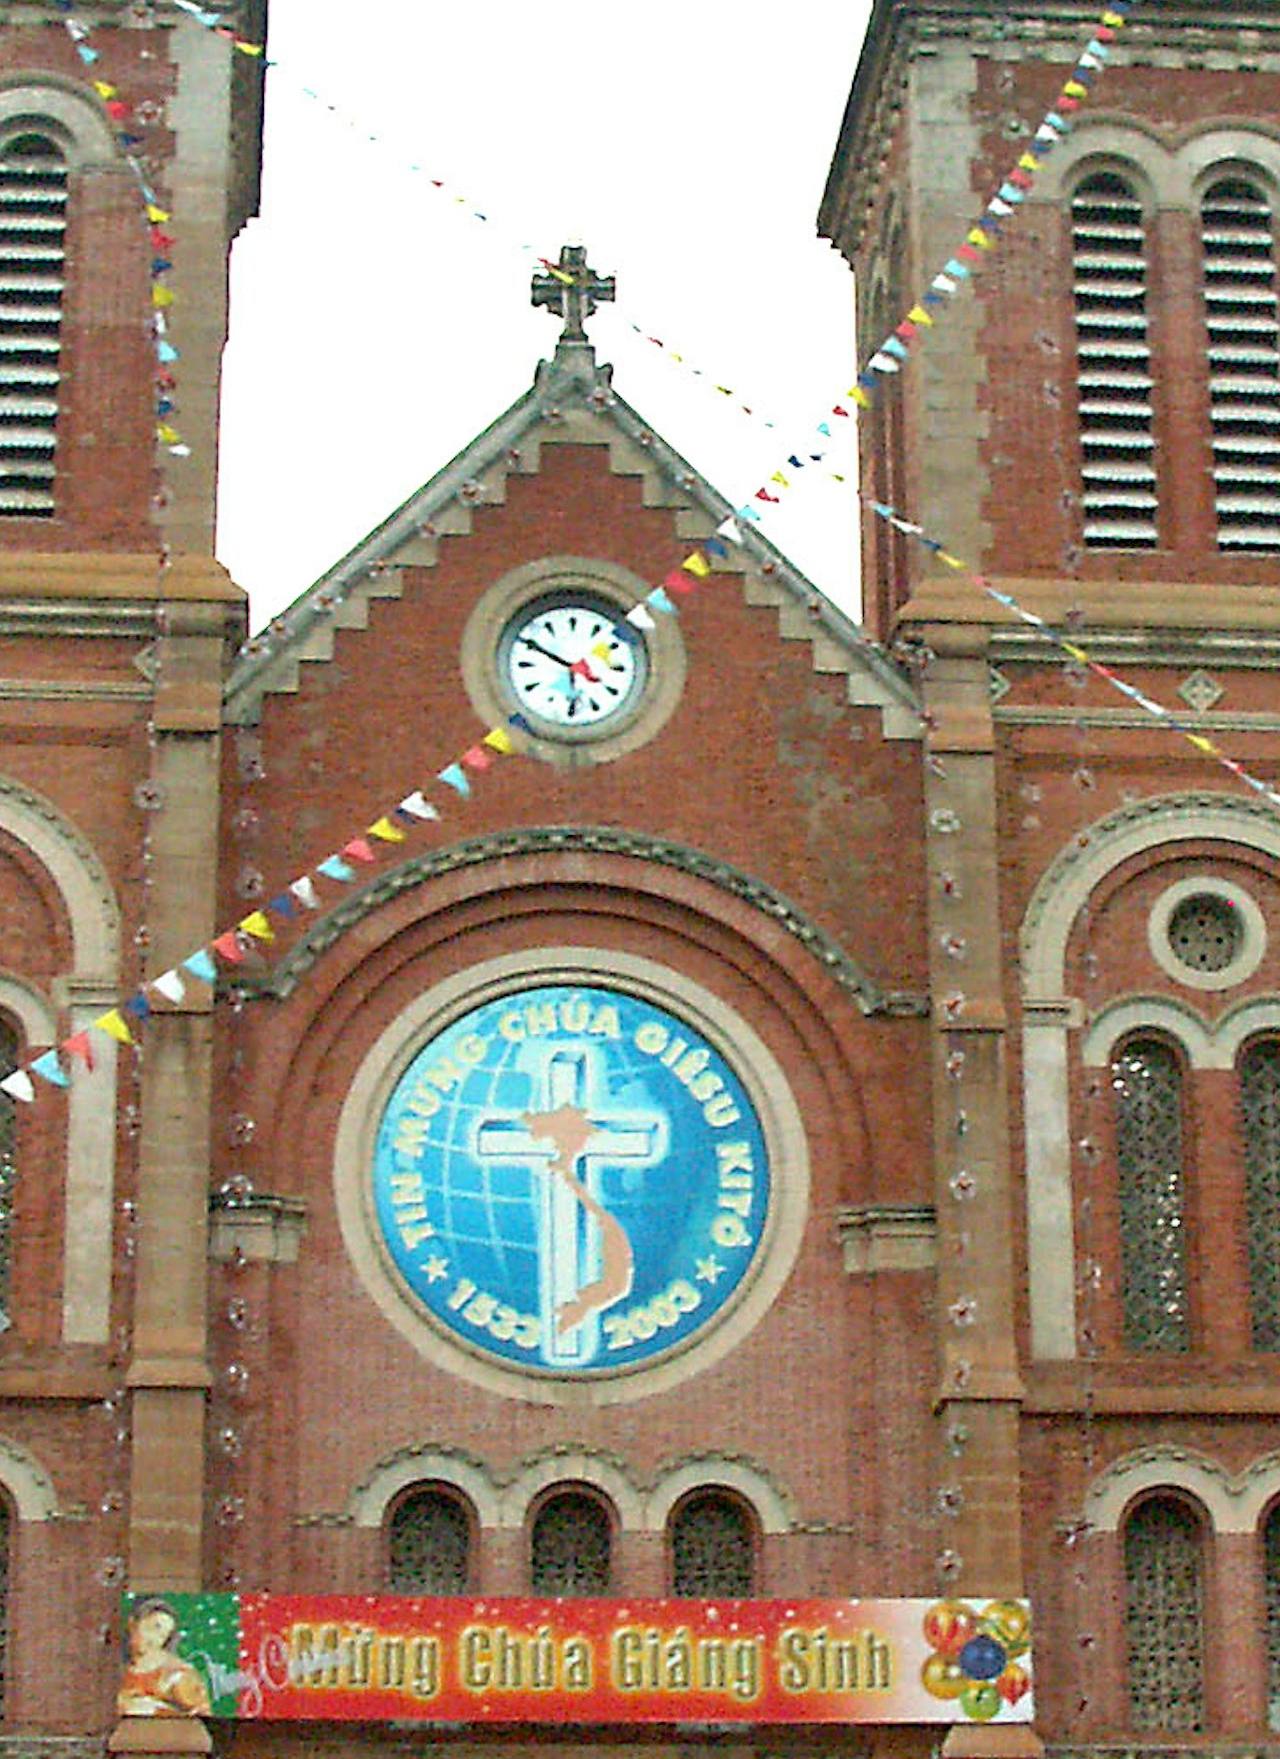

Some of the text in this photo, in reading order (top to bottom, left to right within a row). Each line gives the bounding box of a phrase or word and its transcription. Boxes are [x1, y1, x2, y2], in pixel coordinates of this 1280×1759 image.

[389, 1174, 435, 1251] TIN
[499, 994, 622, 1041] CHÚA
[446, 1278, 541, 1349] 1533
[292, 1625, 439, 1697] Mừng
[461, 1626, 593, 1690] Chúa
[613, 1626, 761, 1700] Giáng
[781, 1627, 891, 1692] Sinh
